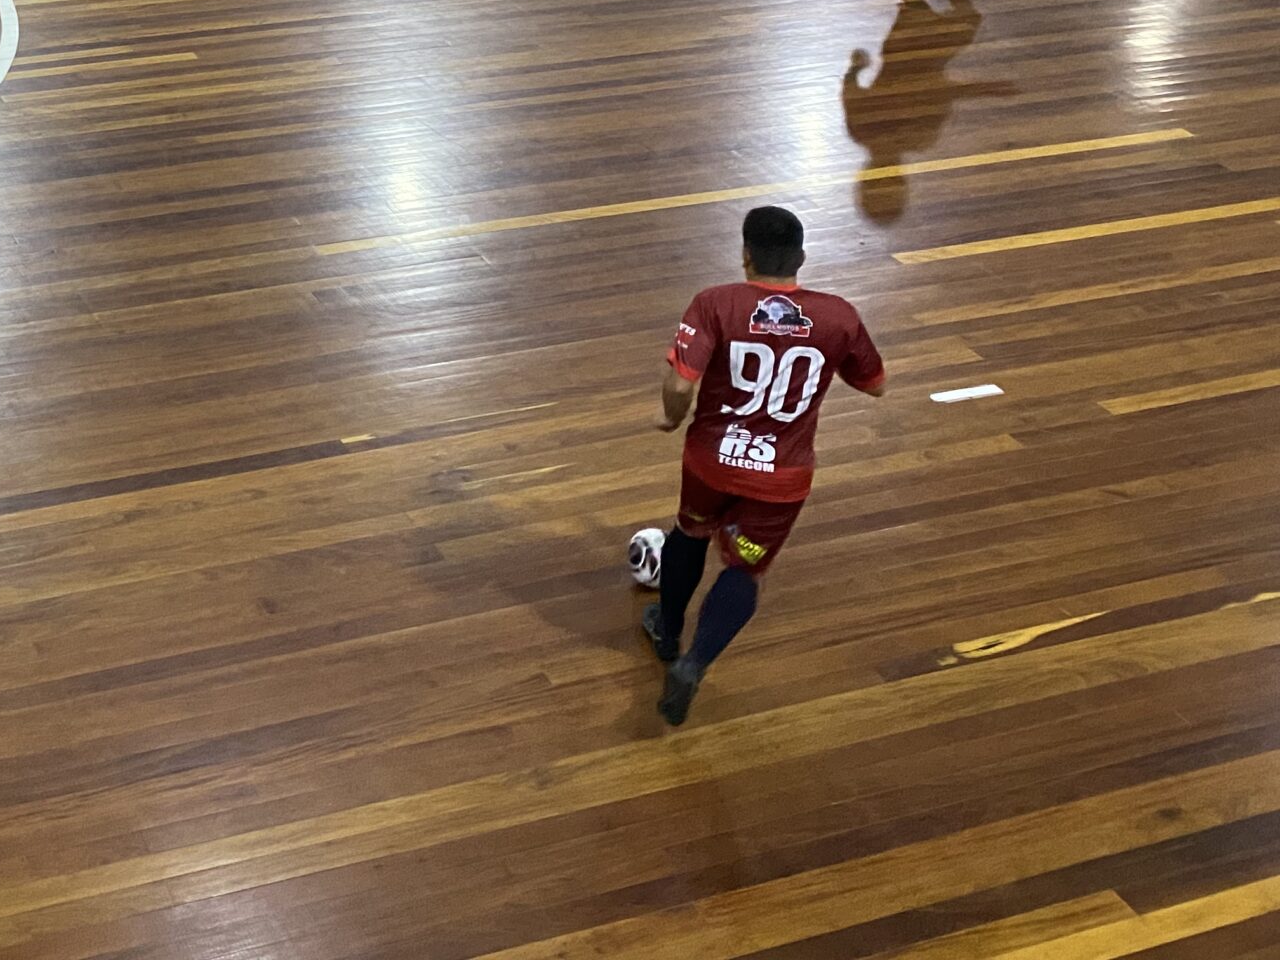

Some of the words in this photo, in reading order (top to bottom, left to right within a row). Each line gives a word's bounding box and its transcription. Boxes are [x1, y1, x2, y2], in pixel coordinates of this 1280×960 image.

[720, 340, 825, 423] 90
[718, 426, 777, 463] RS
[718, 453, 775, 473] TELECOM
